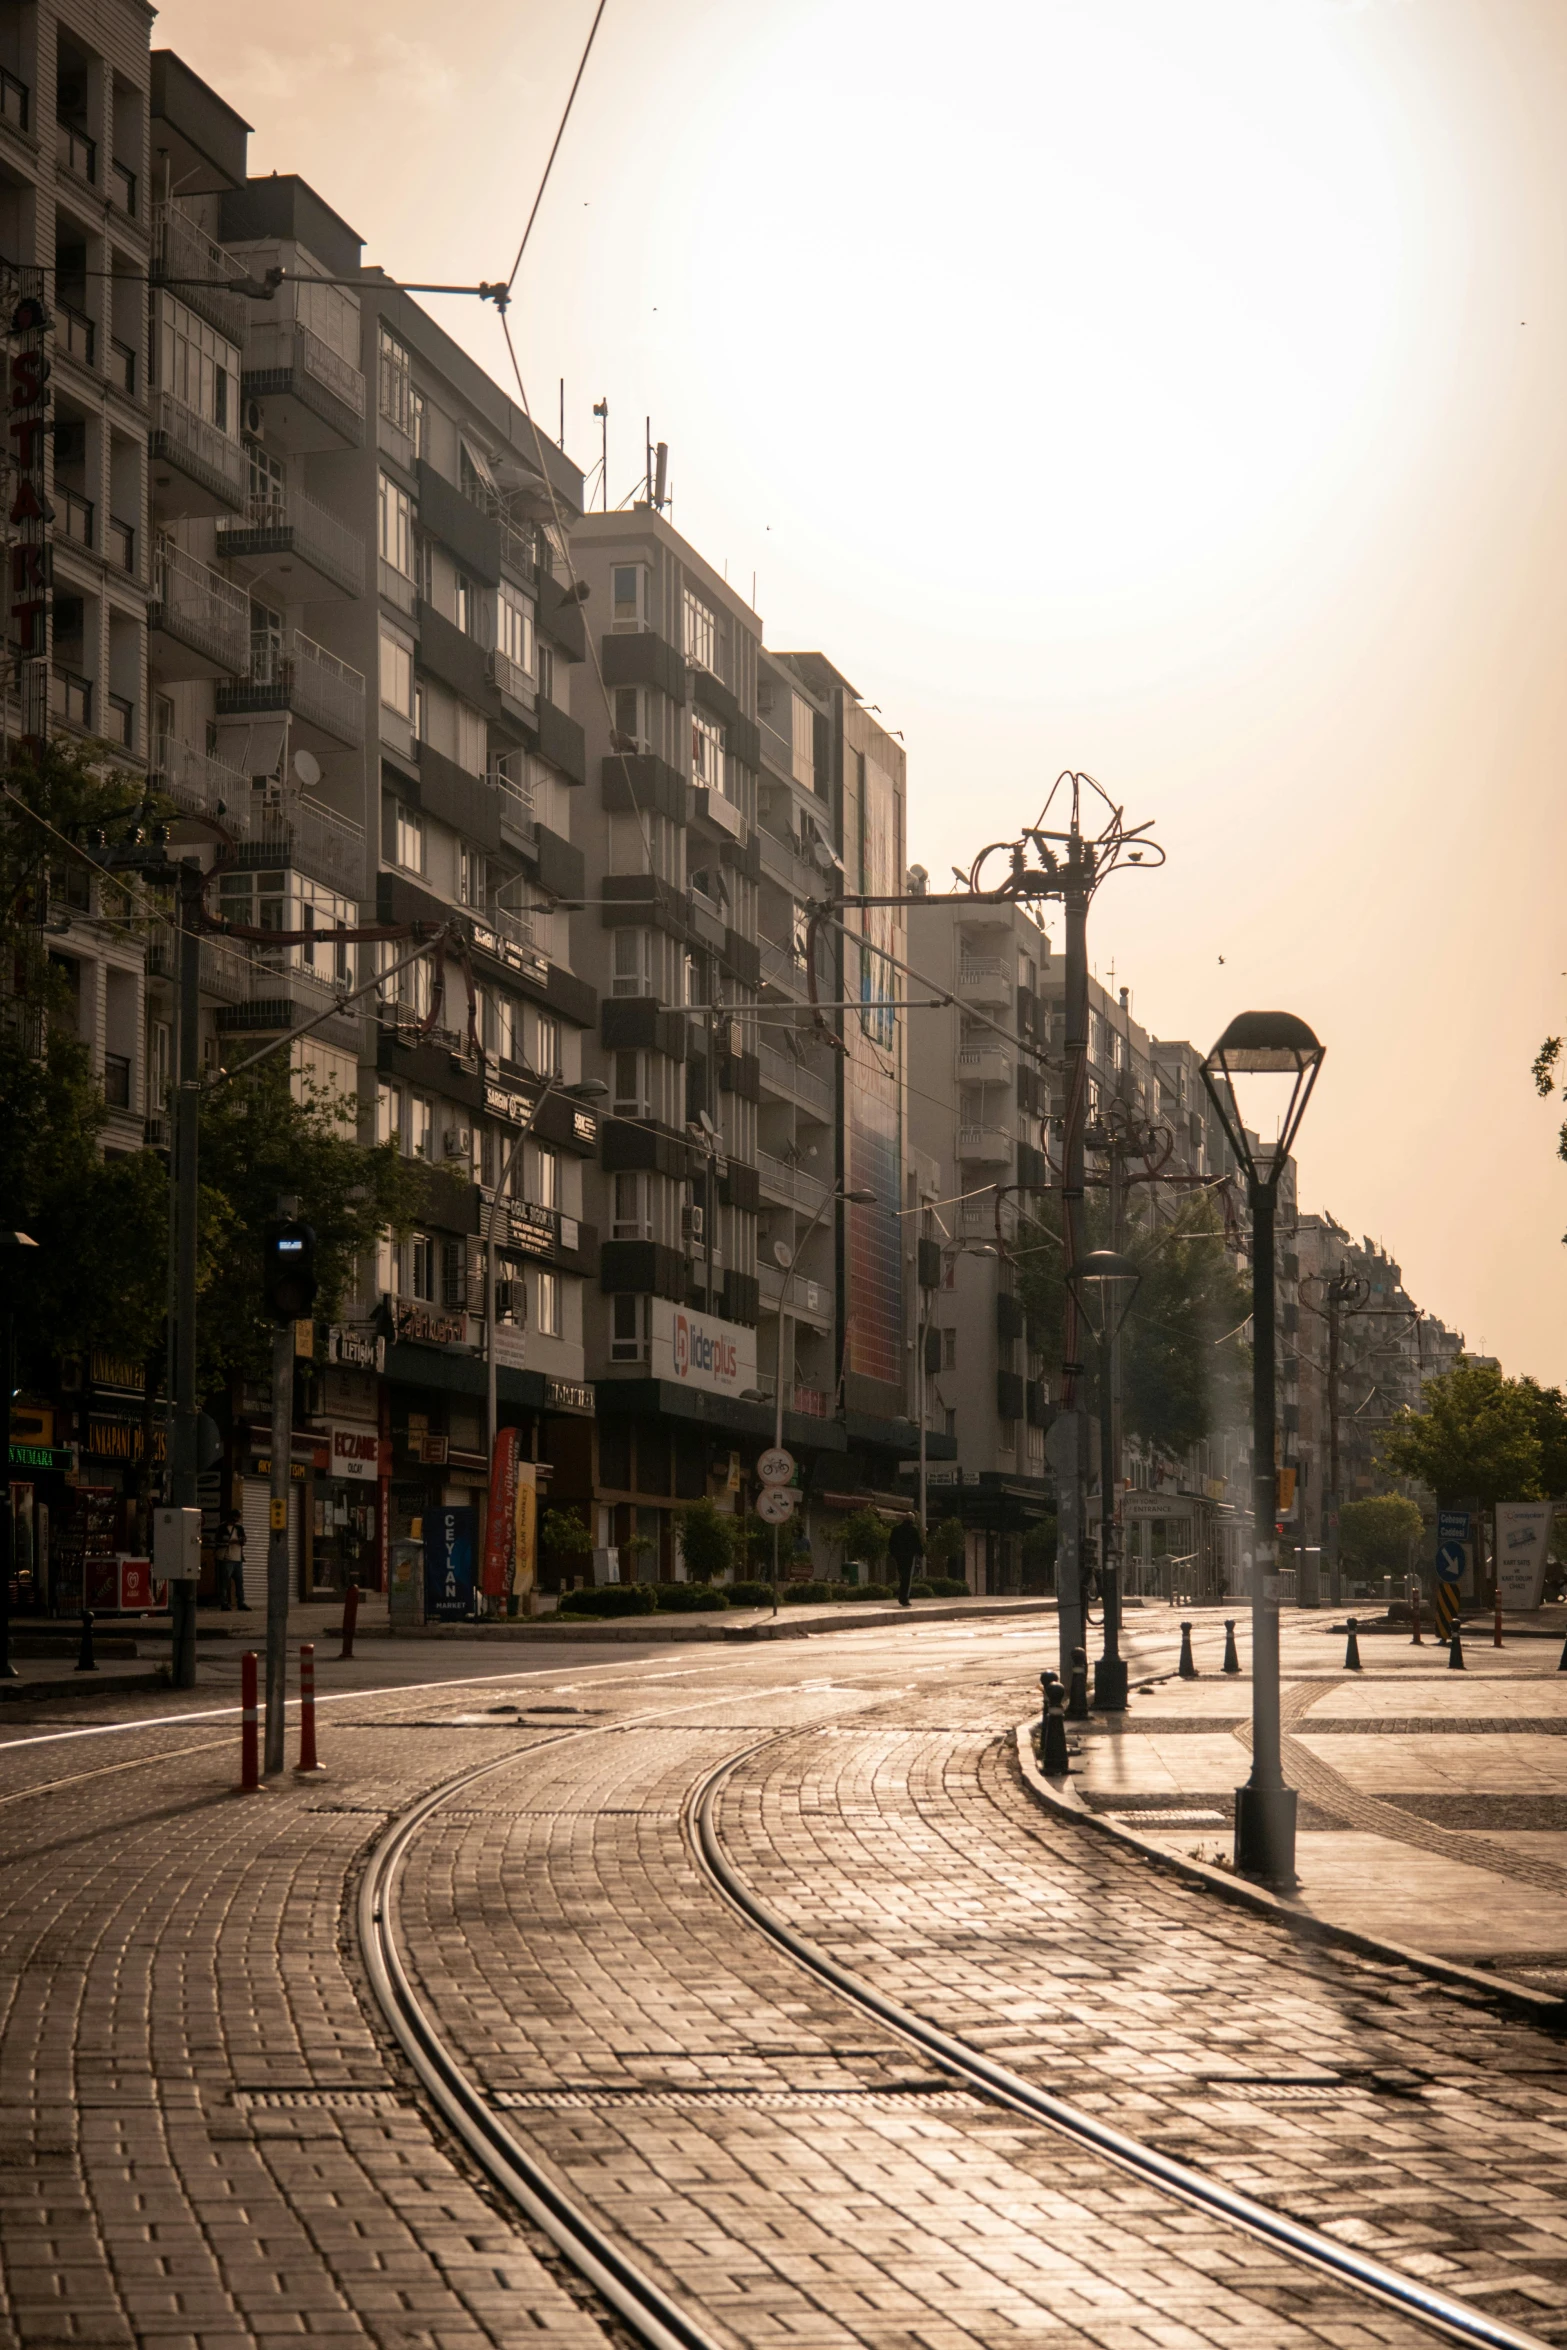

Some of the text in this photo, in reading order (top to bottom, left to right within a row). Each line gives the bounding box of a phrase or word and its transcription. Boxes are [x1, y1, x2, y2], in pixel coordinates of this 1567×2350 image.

[11, 351, 44, 652] START
[335, 1432, 378, 1461] ECZANE
[15, 1448, 53, 1466] NUMARA
[347, 1463, 363, 1475] OLCAY
[1133, 1505, 1171, 1513] ENTRANCE
[444, 1514, 457, 1598] CEYLAN
[435, 1601, 466, 1610] MARKET
